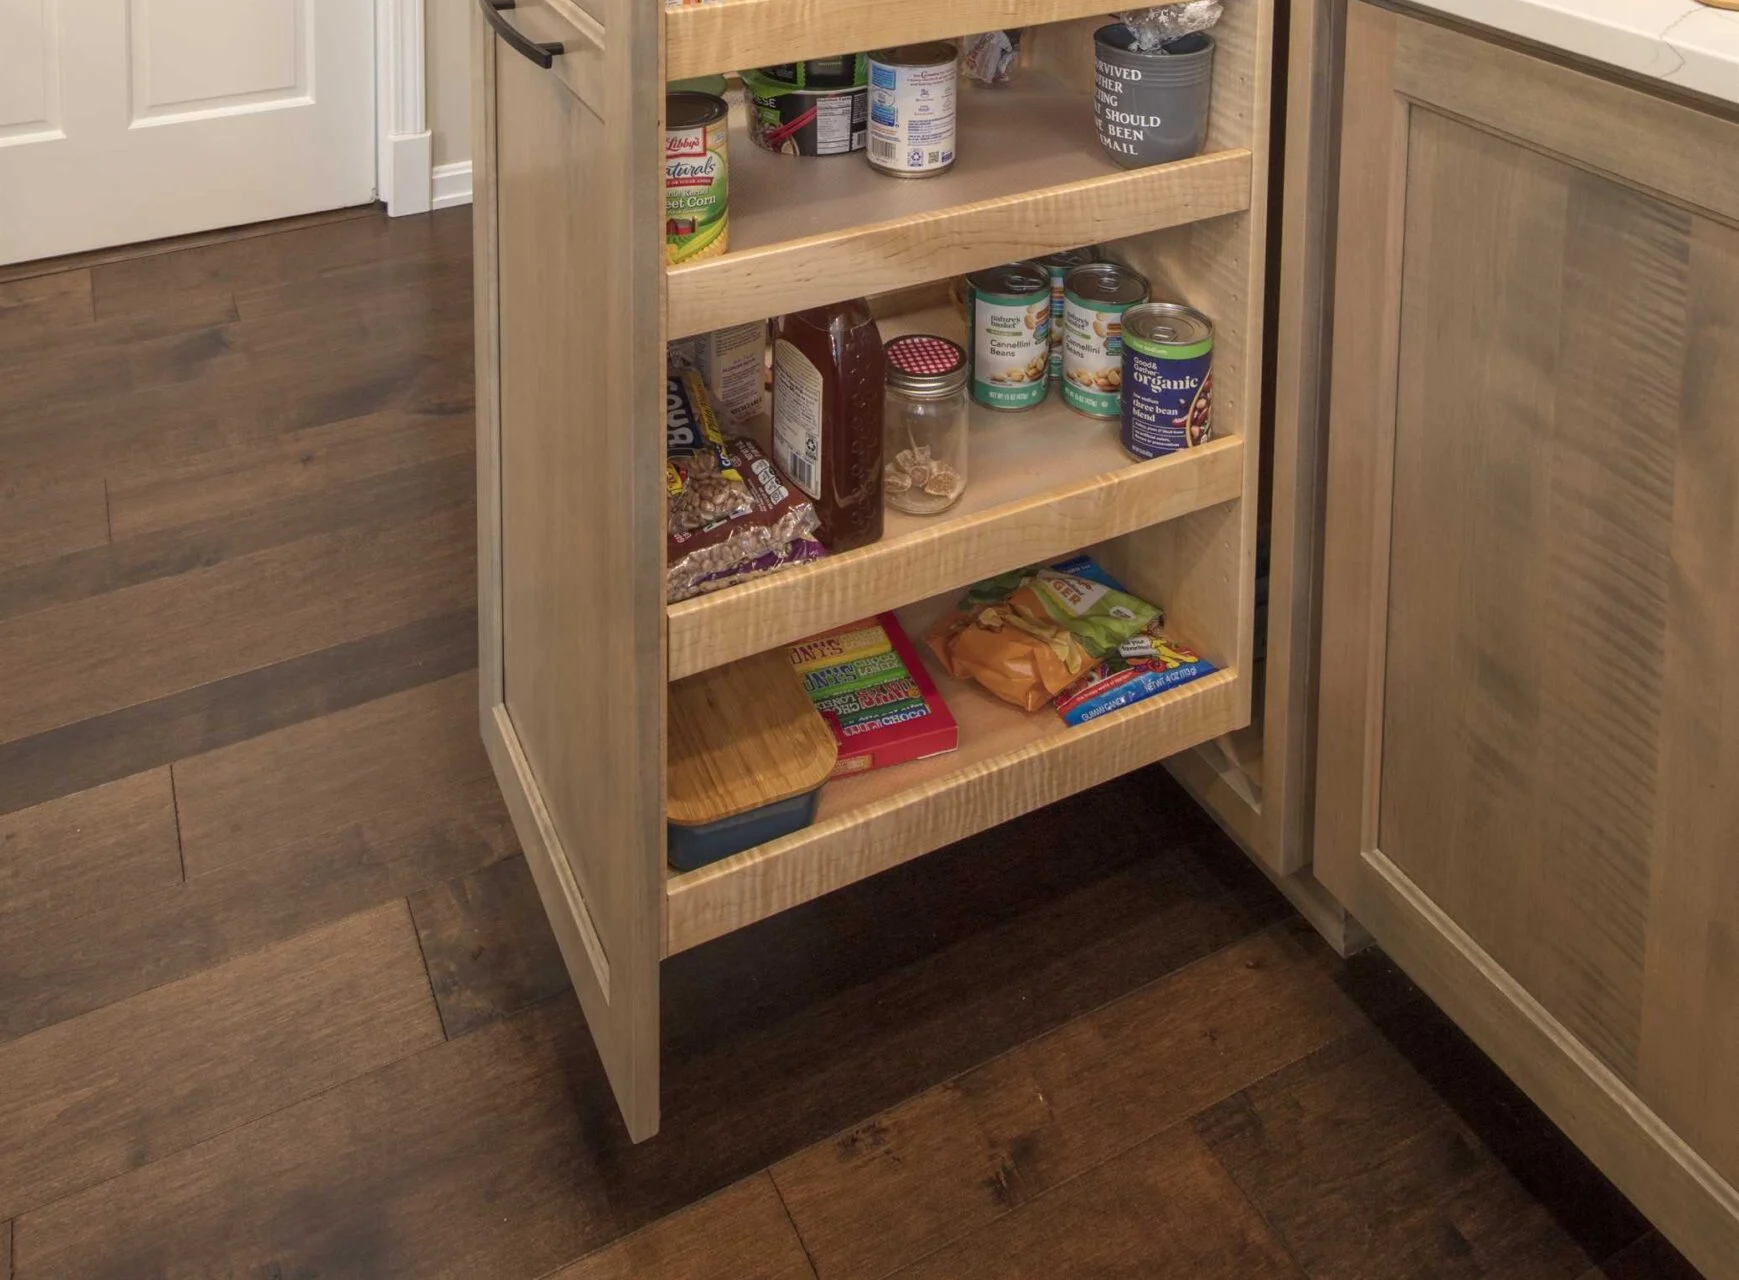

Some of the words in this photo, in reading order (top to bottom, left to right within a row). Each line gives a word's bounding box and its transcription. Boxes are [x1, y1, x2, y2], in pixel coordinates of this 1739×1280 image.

[1097, 75, 1123, 93] THER
[1096, 90, 1117, 107] TING
[1105, 108, 1161, 127] SHOULD
[1108, 124, 1144, 141] BEEN
[667, 136, 700, 152] Libby's
[666, 157, 716, 179] aturals
[687, 195, 716, 207] Corn
[990, 339, 1031, 349] Cannellini
[990, 348, 1016, 357] Beans
[1133, 372, 1199, 394] organic
[1132, 408, 1156, 422] blend
[1133, 399, 1154, 413] three
[1156, 406, 1178, 416] bean
[1052, 581, 1082, 605] GER
